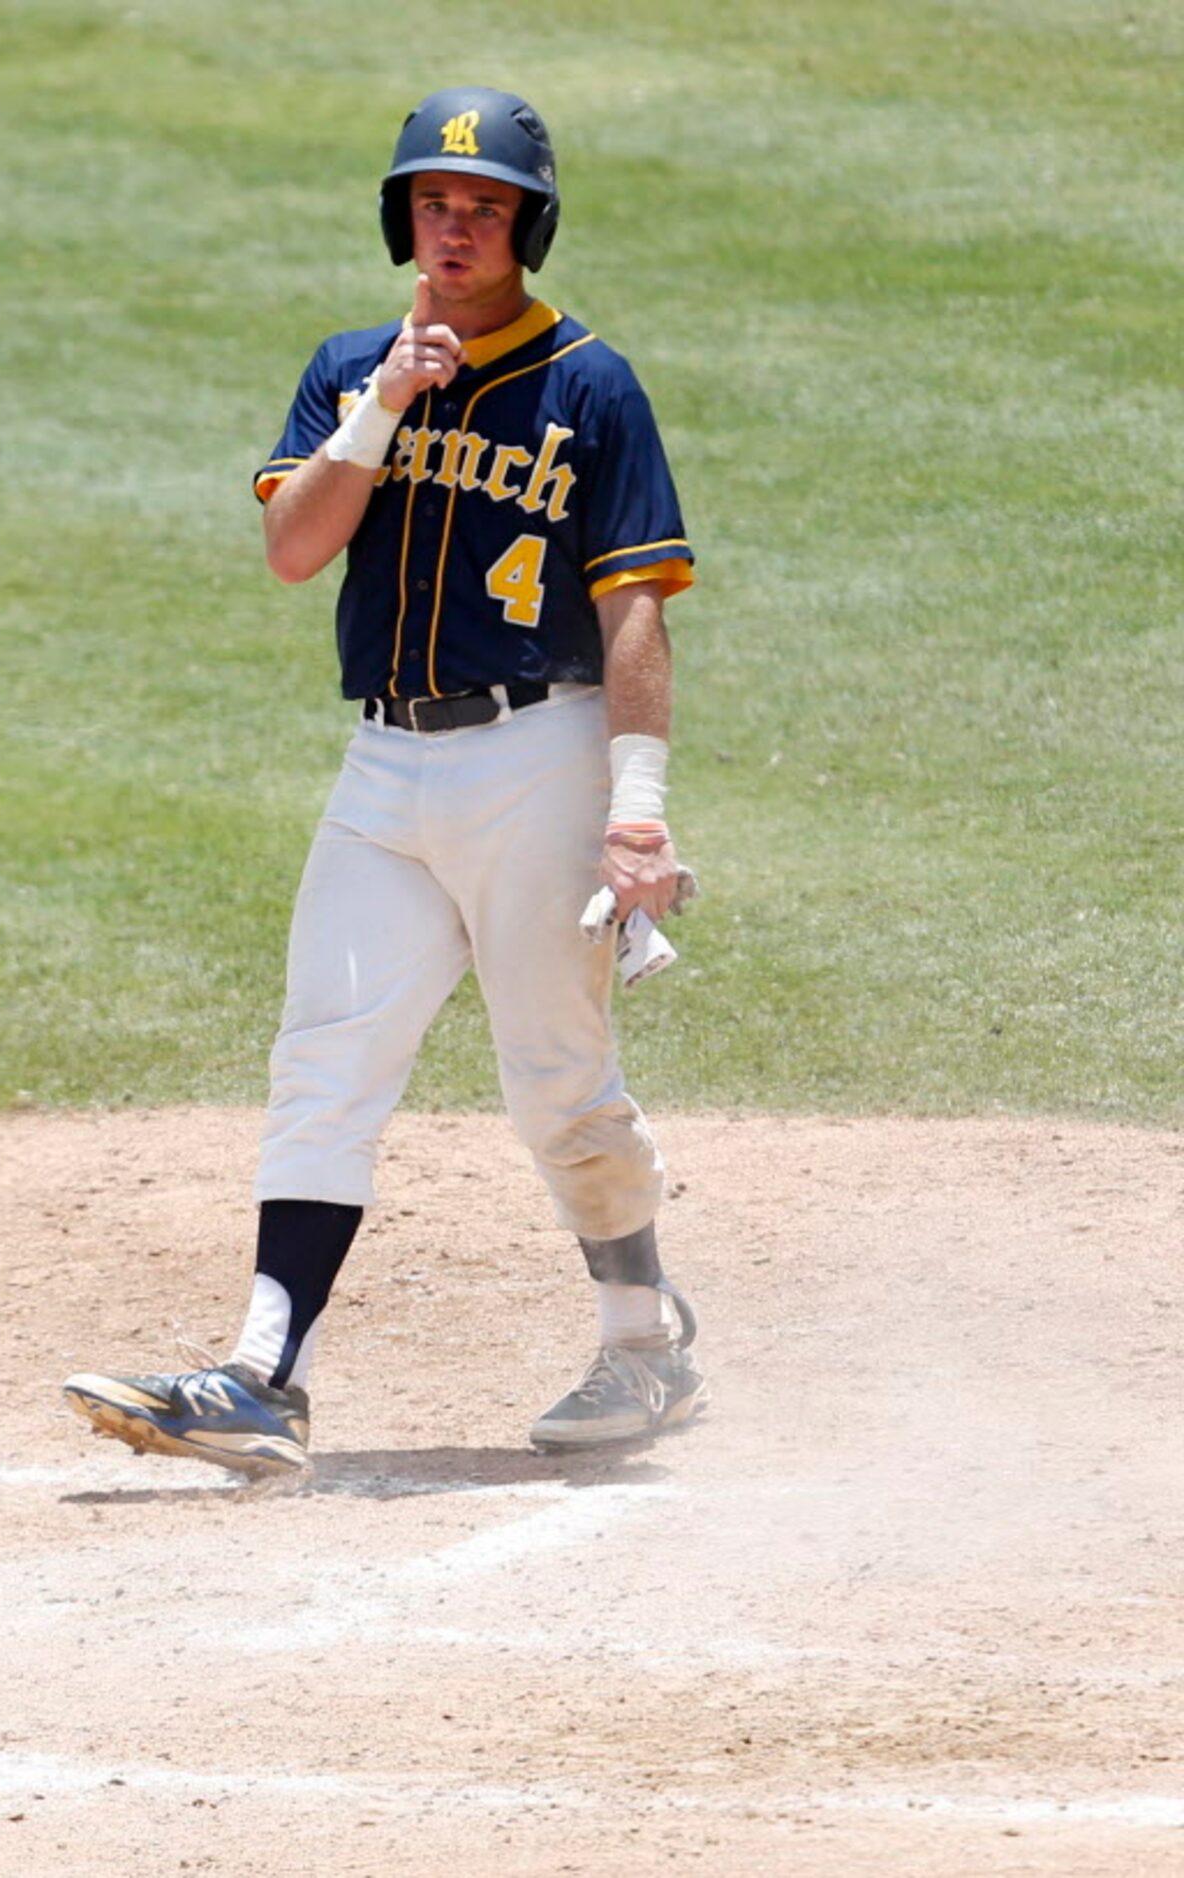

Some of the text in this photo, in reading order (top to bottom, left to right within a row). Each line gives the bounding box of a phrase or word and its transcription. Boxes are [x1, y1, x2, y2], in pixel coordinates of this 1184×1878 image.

[441, 110, 480, 155] R
[338, 378, 576, 522] anch
[487, 534, 548, 627] 4
